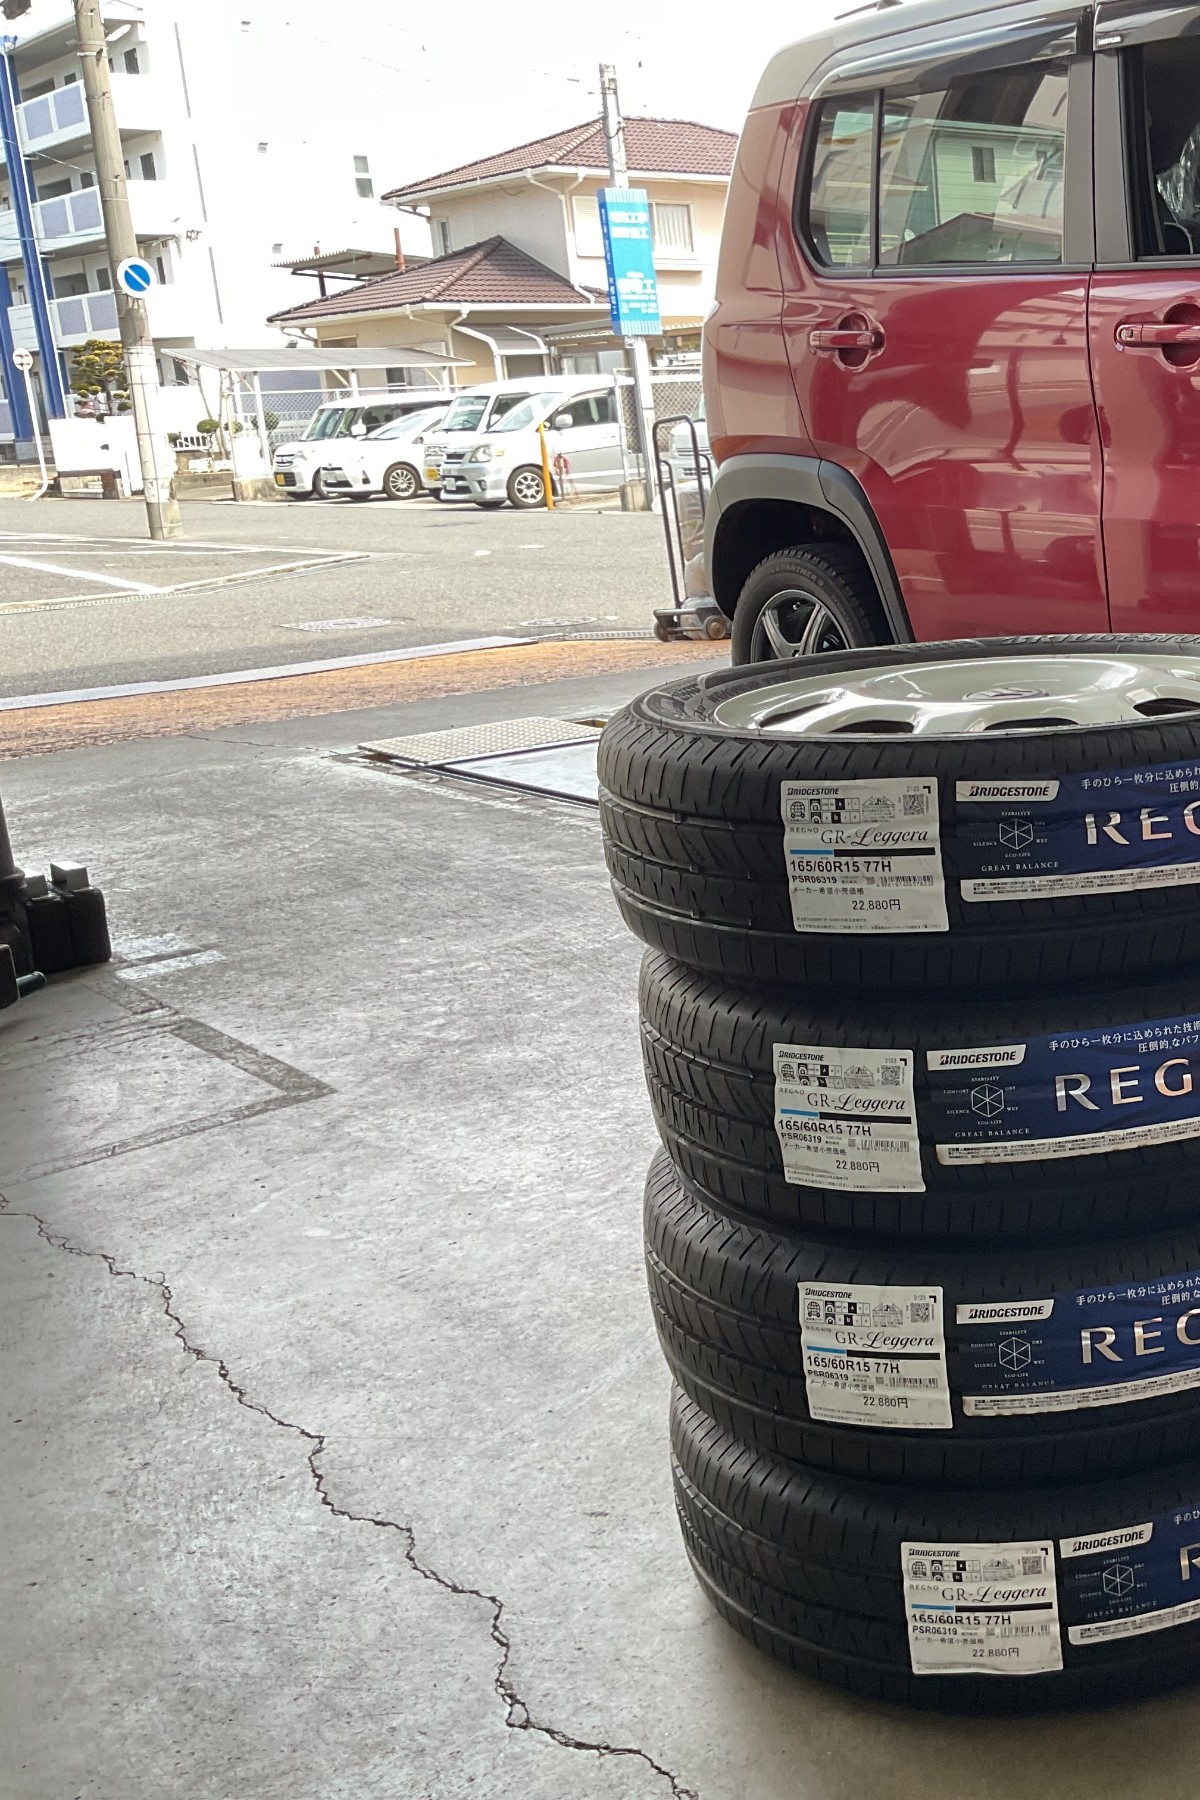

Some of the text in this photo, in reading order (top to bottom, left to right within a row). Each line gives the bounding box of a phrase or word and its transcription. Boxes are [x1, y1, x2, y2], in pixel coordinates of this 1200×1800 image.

[787, 787, 840, 796] BRIDGESTONE
[968, 784, 1050, 797] BRIDGESTONE
[821, 827, 928, 847] GR-Leggera
[790, 860, 891, 873] 165/60R15 77H
[981, 861, 1059, 872] GREAT BALANCE
[792, 875, 837, 884] PSR06319
[791, 887, 864, 896] メーカー希望小売価格
[778, 1050, 825, 1061] BRIDGESTONE
[939, 1050, 1016, 1066] BRIDGESTONE
[778, 1087, 805, 1096] REGNO
[807, 1093, 906, 1112] GR-Leggera
[778, 1120, 872, 1136] 165/60R15 77H
[988, 1128, 1030, 1136] BALANCE
[781, 1132, 822, 1144] PSR06319
[783, 1142, 847, 1155] メーカー希望小売価格
[805, 1287, 852, 1299] BRIDGESTONE
[967, 1305, 1044, 1319] BRIDGESTONE
[805, 1325, 832, 1333] REGNO
[835, 1331, 934, 1350] GR-Leggera
[806, 1356, 900, 1374] 165/60R15 77H
[807, 1369, 849, 1381] PSR06319
[809, 1379, 875, 1392] メーカー希望小売価格
[1014, 1379, 1055, 1388] BALANCE
[1072, 1530, 1145, 1552] BRIDGESTONE
[908, 1548, 961, 1558] BRIDGESTONE
[941, 1585, 1047, 1604] GR-Leggera
[911, 1613, 1011, 1625] 165/60R15 77H
[912, 1625, 958, 1636] PSR06319
[913, 1637, 984, 1645] メーカー希望小売価格
